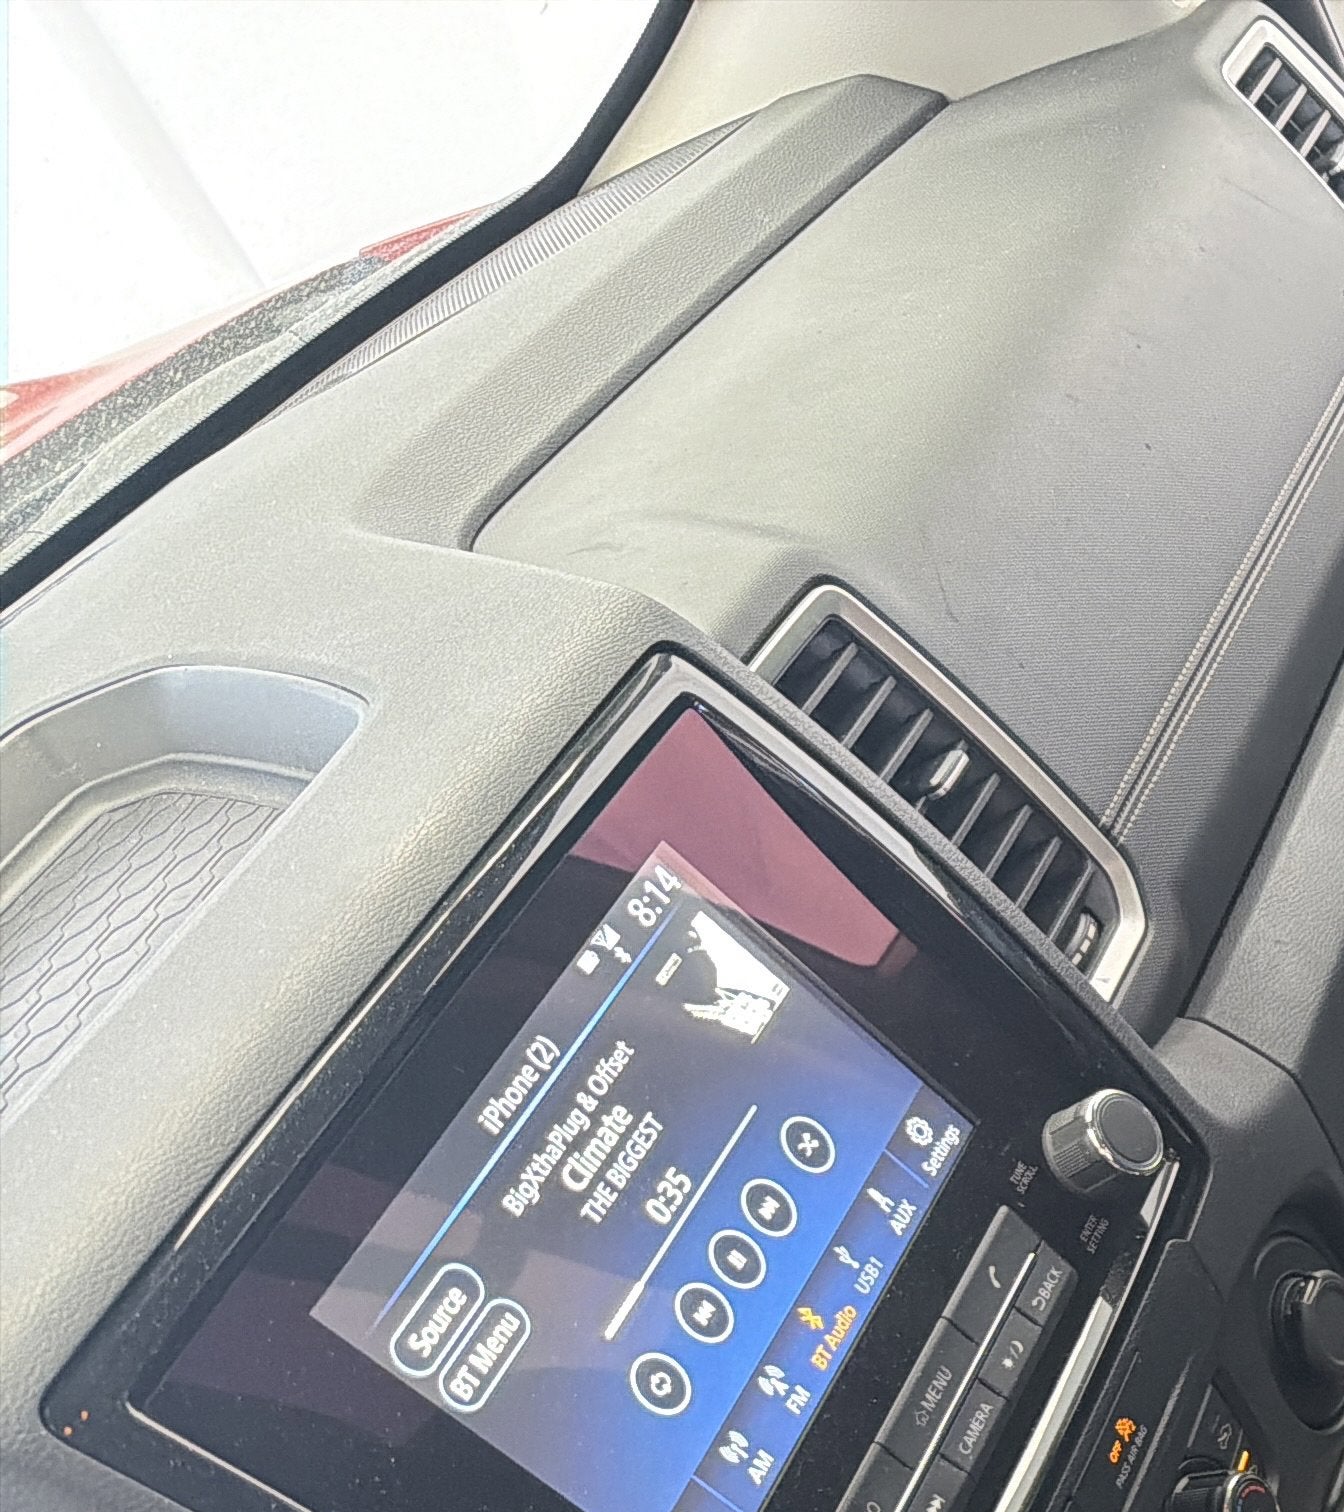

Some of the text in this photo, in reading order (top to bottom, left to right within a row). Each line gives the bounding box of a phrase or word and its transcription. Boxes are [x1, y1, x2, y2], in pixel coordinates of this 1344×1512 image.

[627, 865, 682, 928] 8:14
[478, 1035, 561, 1136] iPhone (2)
[501, 1040, 635, 1217] BigXthaPlug & Offset
[562, 1104, 634, 1192] Climate
[921, 1124, 961, 1177] Settings
[580, 1111, 664, 1224] THE BIGGEST
[645, 1166, 692, 1225] 0:35
[888, 1198, 918, 1236] AUX
[854, 1256, 884, 1295] USB1
[1039, 1266, 1063, 1301] BACK
[407, 1286, 468, 1358] Source
[810, 1305, 858, 1372] BT Audio
[449, 1311, 521, 1403] BT Menu
[785, 1384, 812, 1415] FM
[926, 1367, 953, 1413] MENU
[958, 1402, 994, 1455] CAMERA
[747, 1448, 775, 1485] AM
